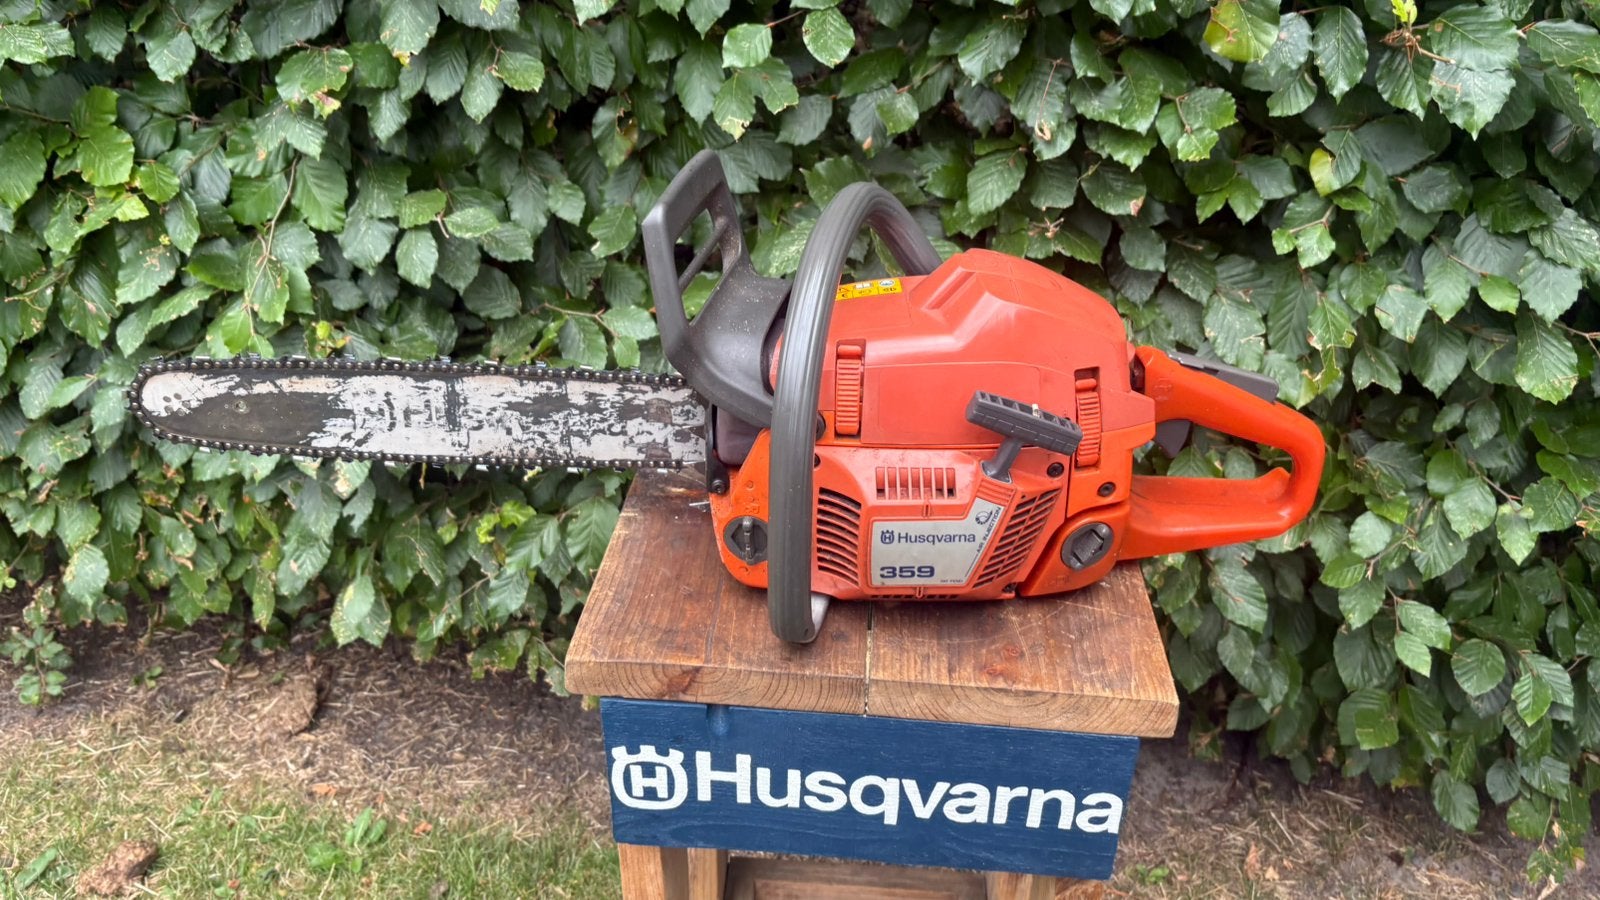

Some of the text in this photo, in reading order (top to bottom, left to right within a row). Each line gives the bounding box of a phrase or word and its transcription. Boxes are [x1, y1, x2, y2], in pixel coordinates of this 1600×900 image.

[982, 506, 1002, 541] INJECTION
[897, 532, 976, 546] Husqvarna
[879, 565, 936, 579] 359
[694, 750, 1124, 834] Husqvarna
